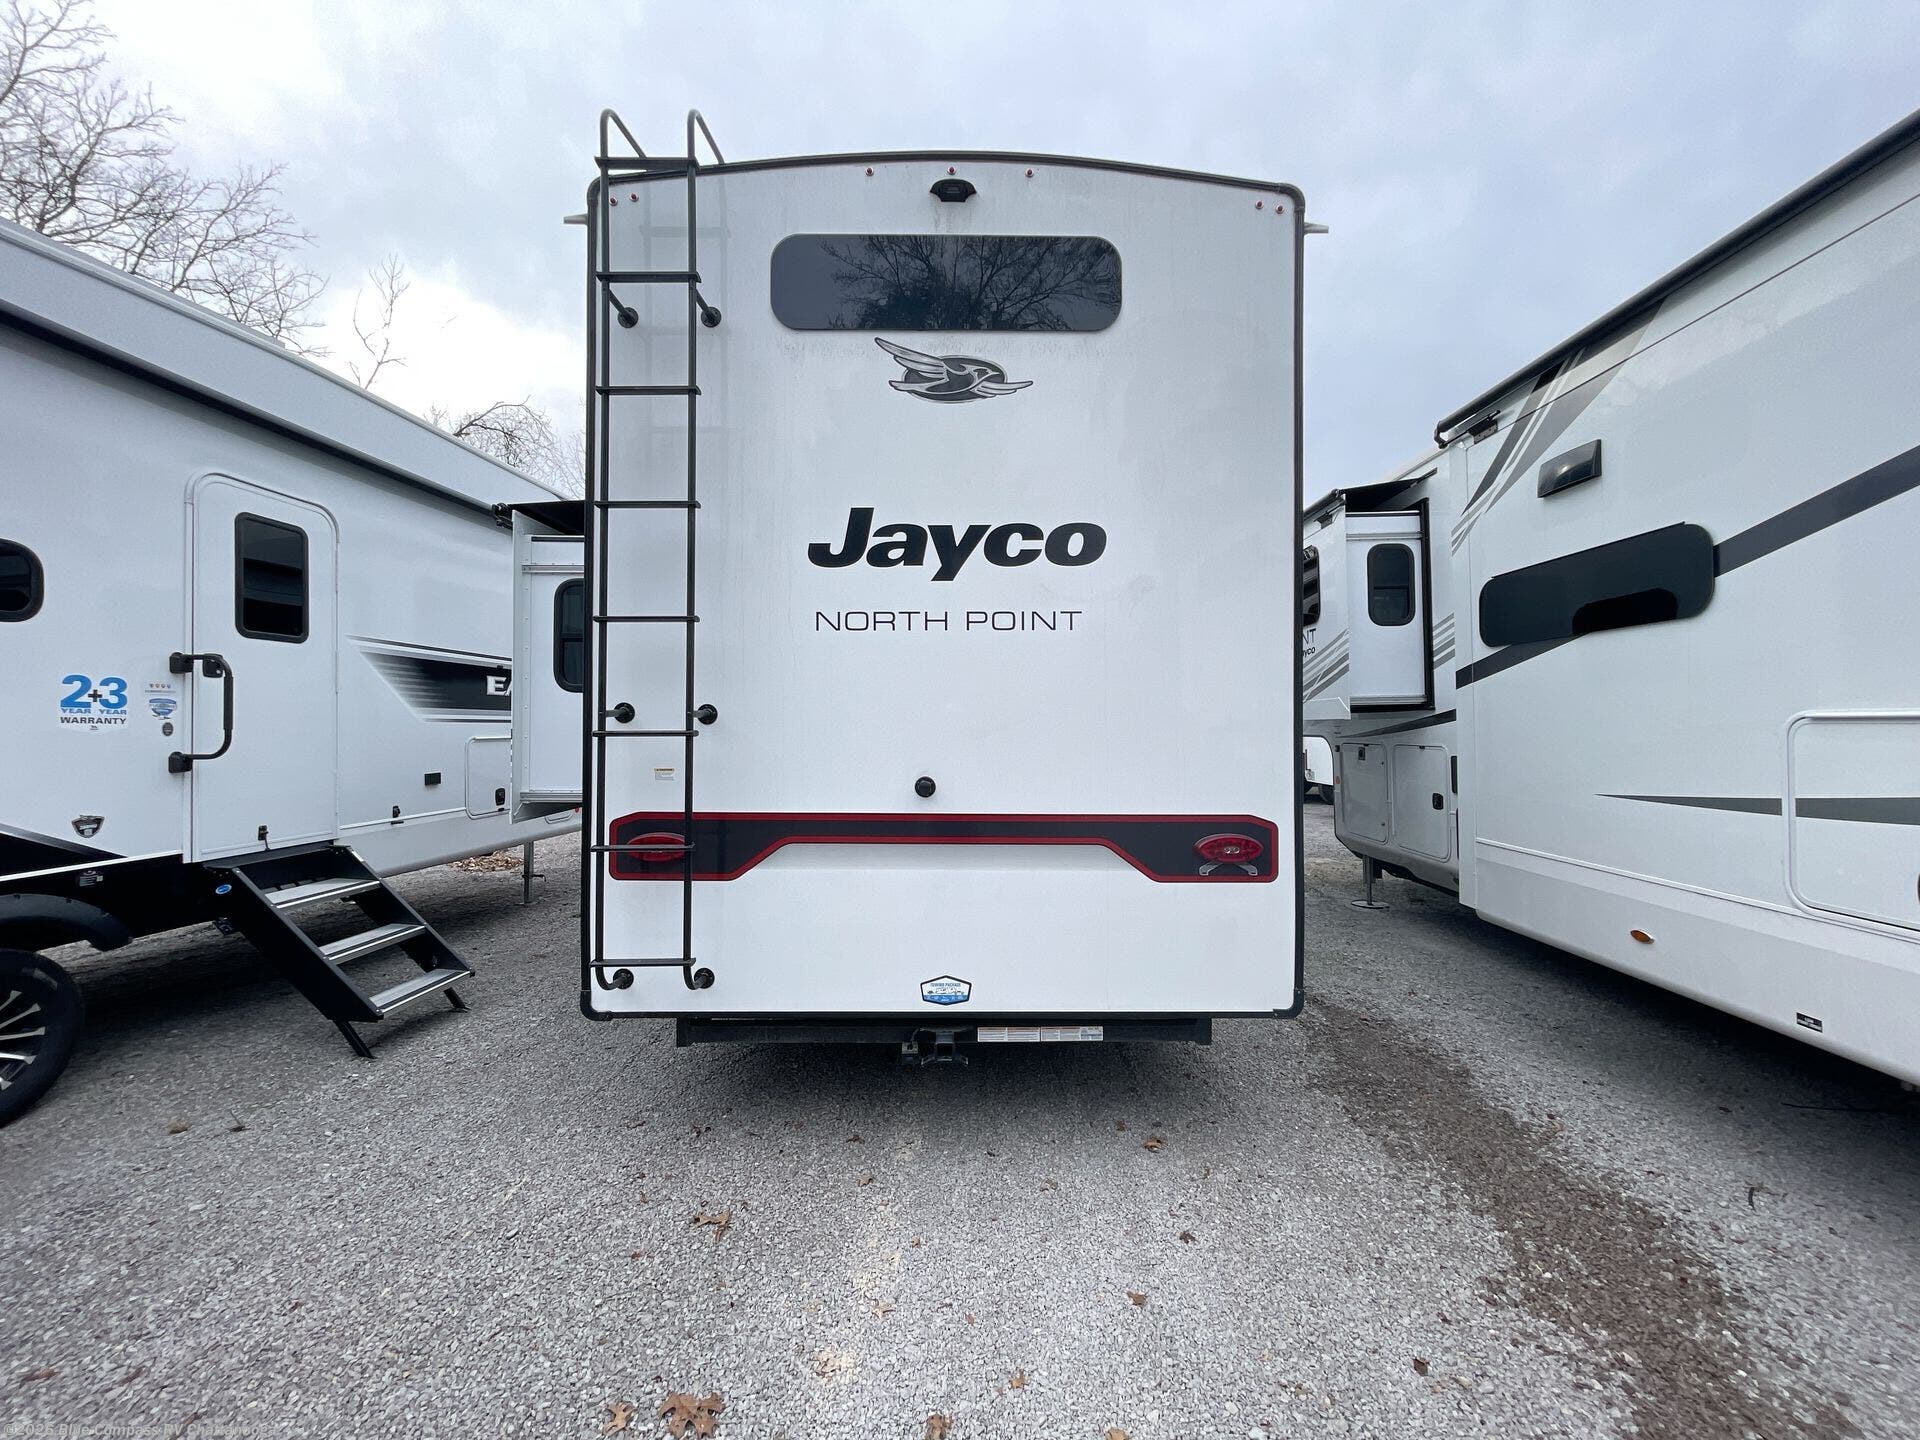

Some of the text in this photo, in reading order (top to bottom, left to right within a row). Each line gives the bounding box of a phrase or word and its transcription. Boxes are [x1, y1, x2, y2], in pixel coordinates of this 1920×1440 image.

[807, 507, 1107, 581] Jayco
[816, 611, 1082, 631] NORTH POINT
[60, 716, 127, 725] WARRANTY
